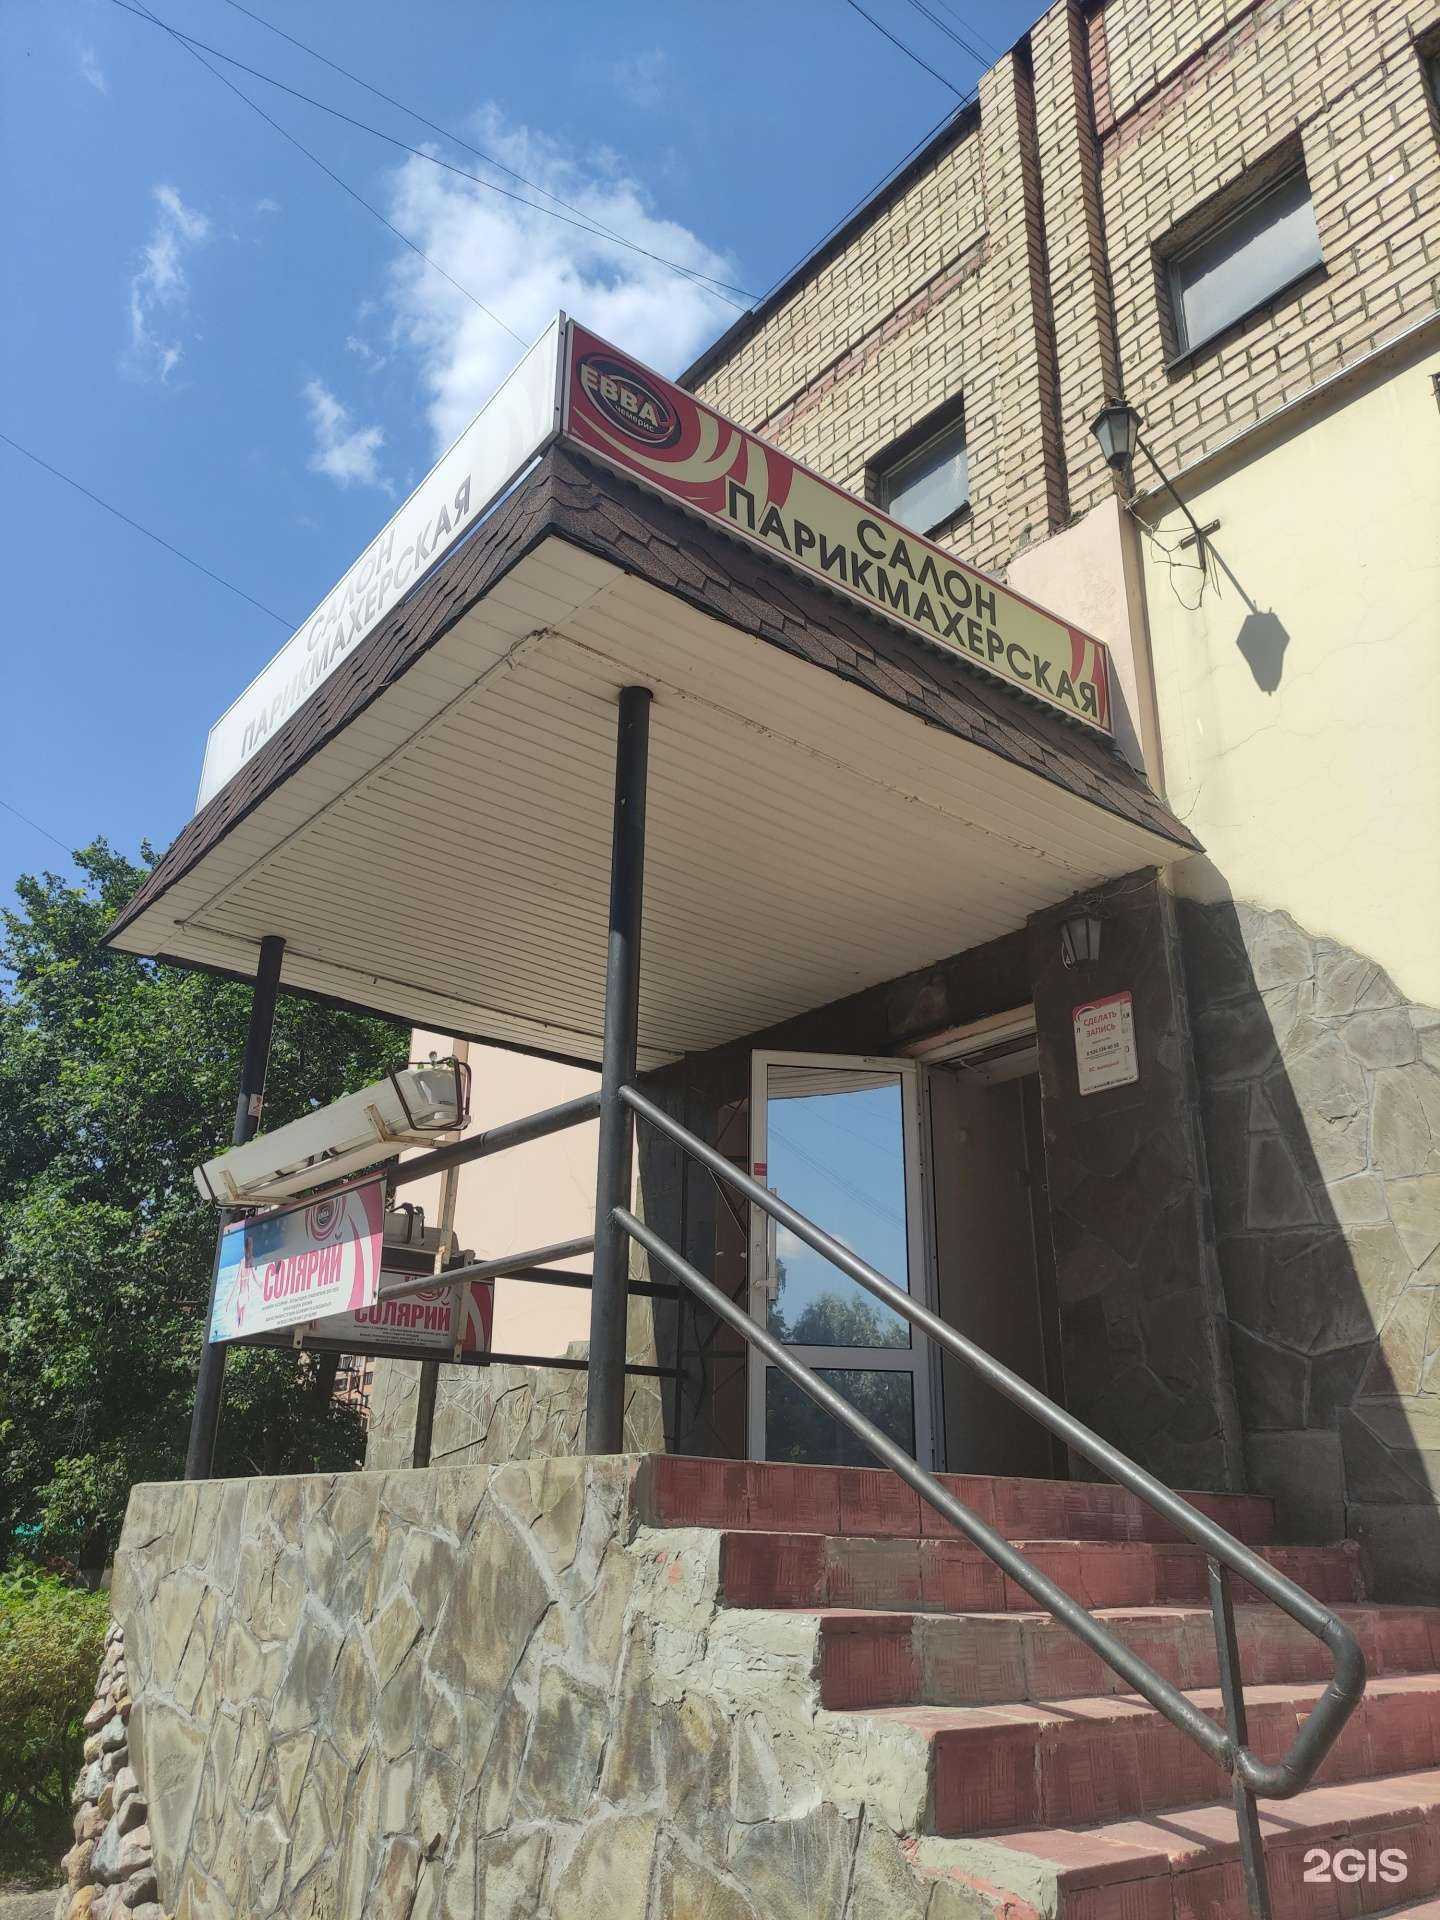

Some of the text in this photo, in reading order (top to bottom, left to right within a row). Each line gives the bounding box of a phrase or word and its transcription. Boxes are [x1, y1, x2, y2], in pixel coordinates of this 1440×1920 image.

[580, 363, 660, 428] ЕВВА
[240, 473, 472, 759] ПАРИКМАХЕРСКАЯ
[306, 528, 396, 652] САЛОН
[727, 479, 1099, 718] ПАРИКМАХЕРСКАЯ
[856, 518, 997, 626] САЛОН
[263, 1233, 344, 1302] СОЛЯРИЙ
